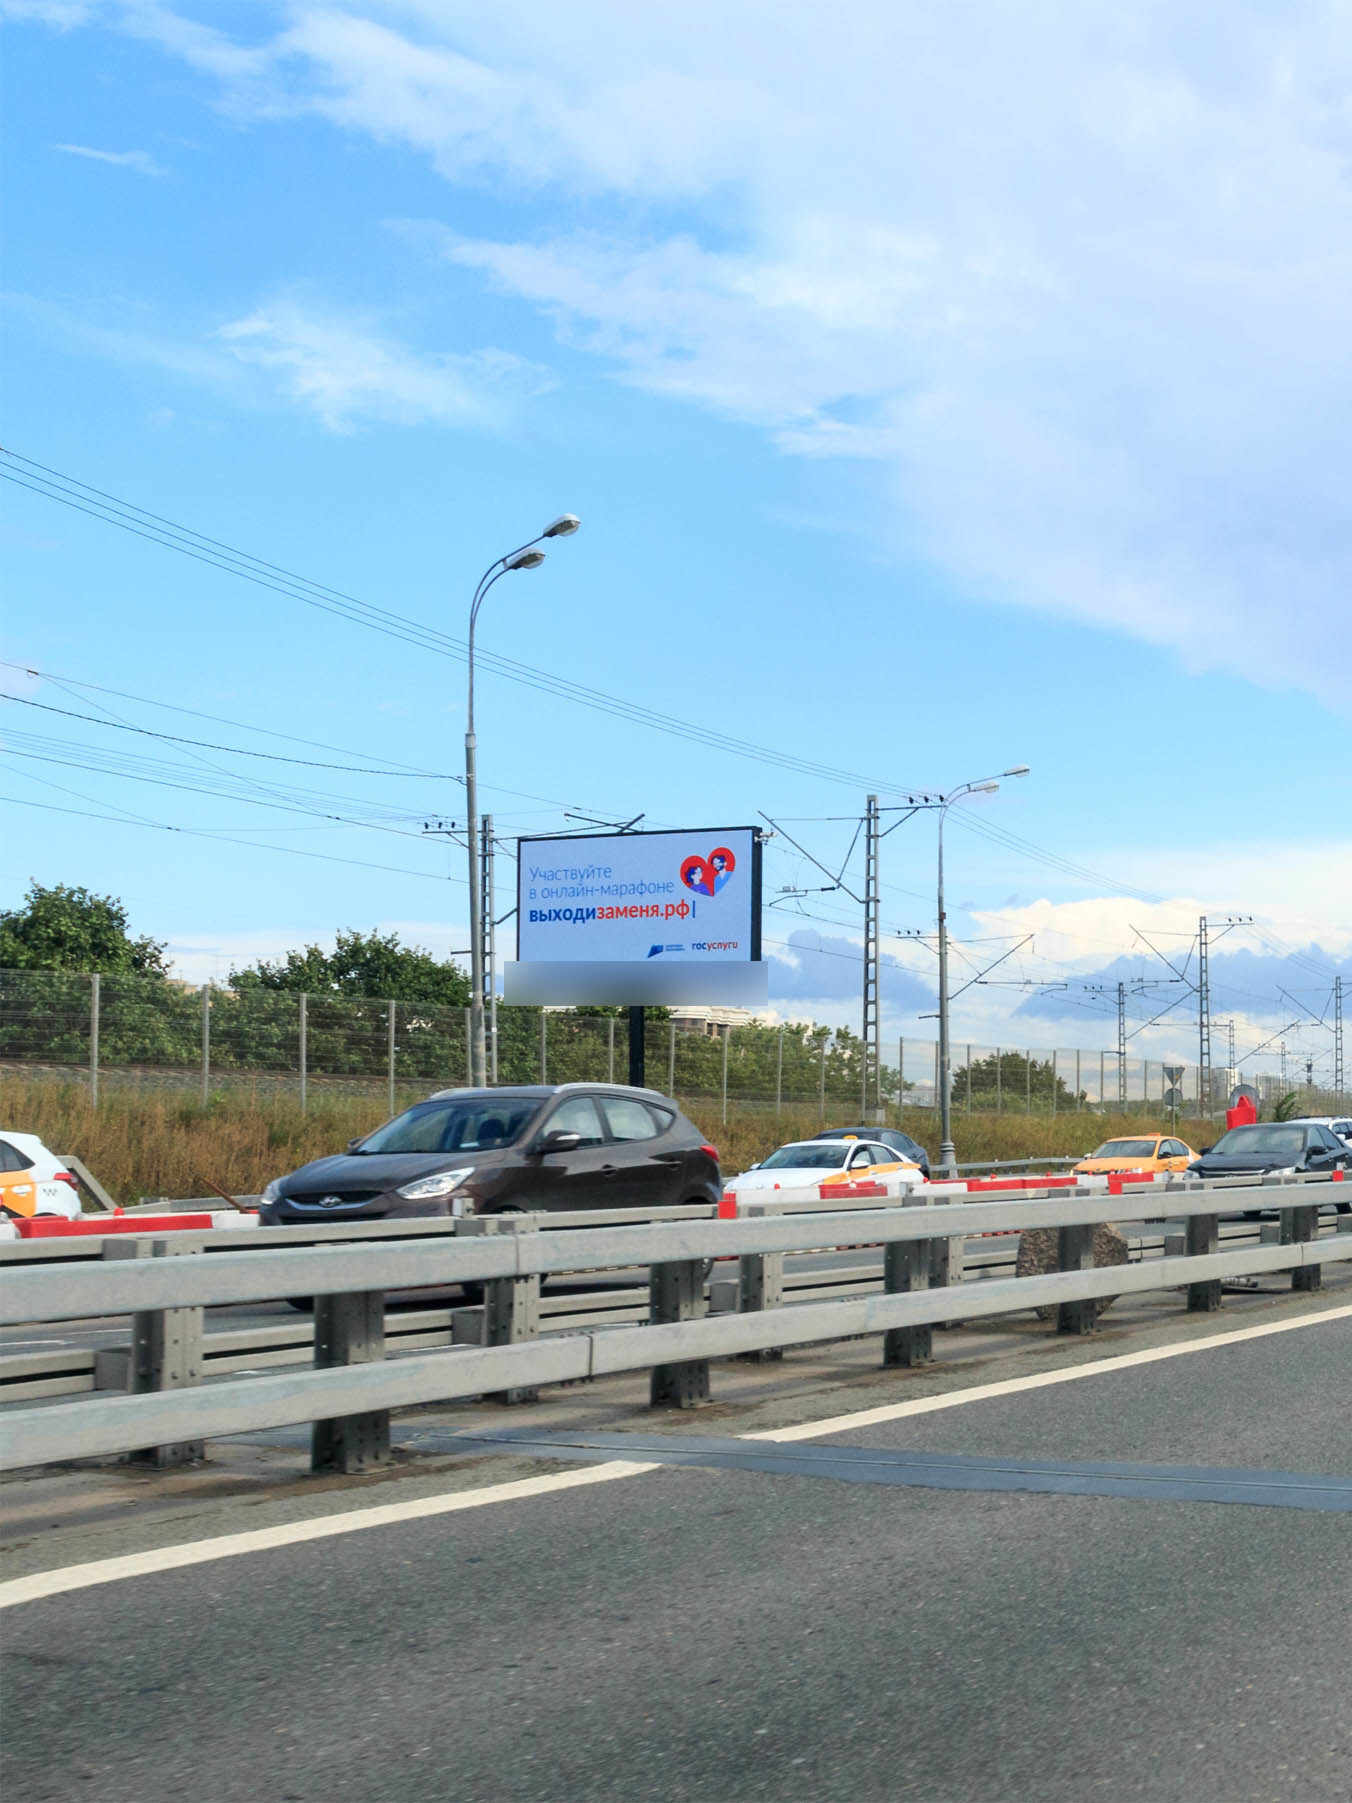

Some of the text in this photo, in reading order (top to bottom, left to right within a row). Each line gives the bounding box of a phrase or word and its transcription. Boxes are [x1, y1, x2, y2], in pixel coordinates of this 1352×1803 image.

[529, 865, 612, 882] Участвуйте
[529, 880, 674, 899] в онлайн-марафоне
[529, 899, 690, 923] выходизаменя.рф
[692, 940, 738, 952] госуслуги
